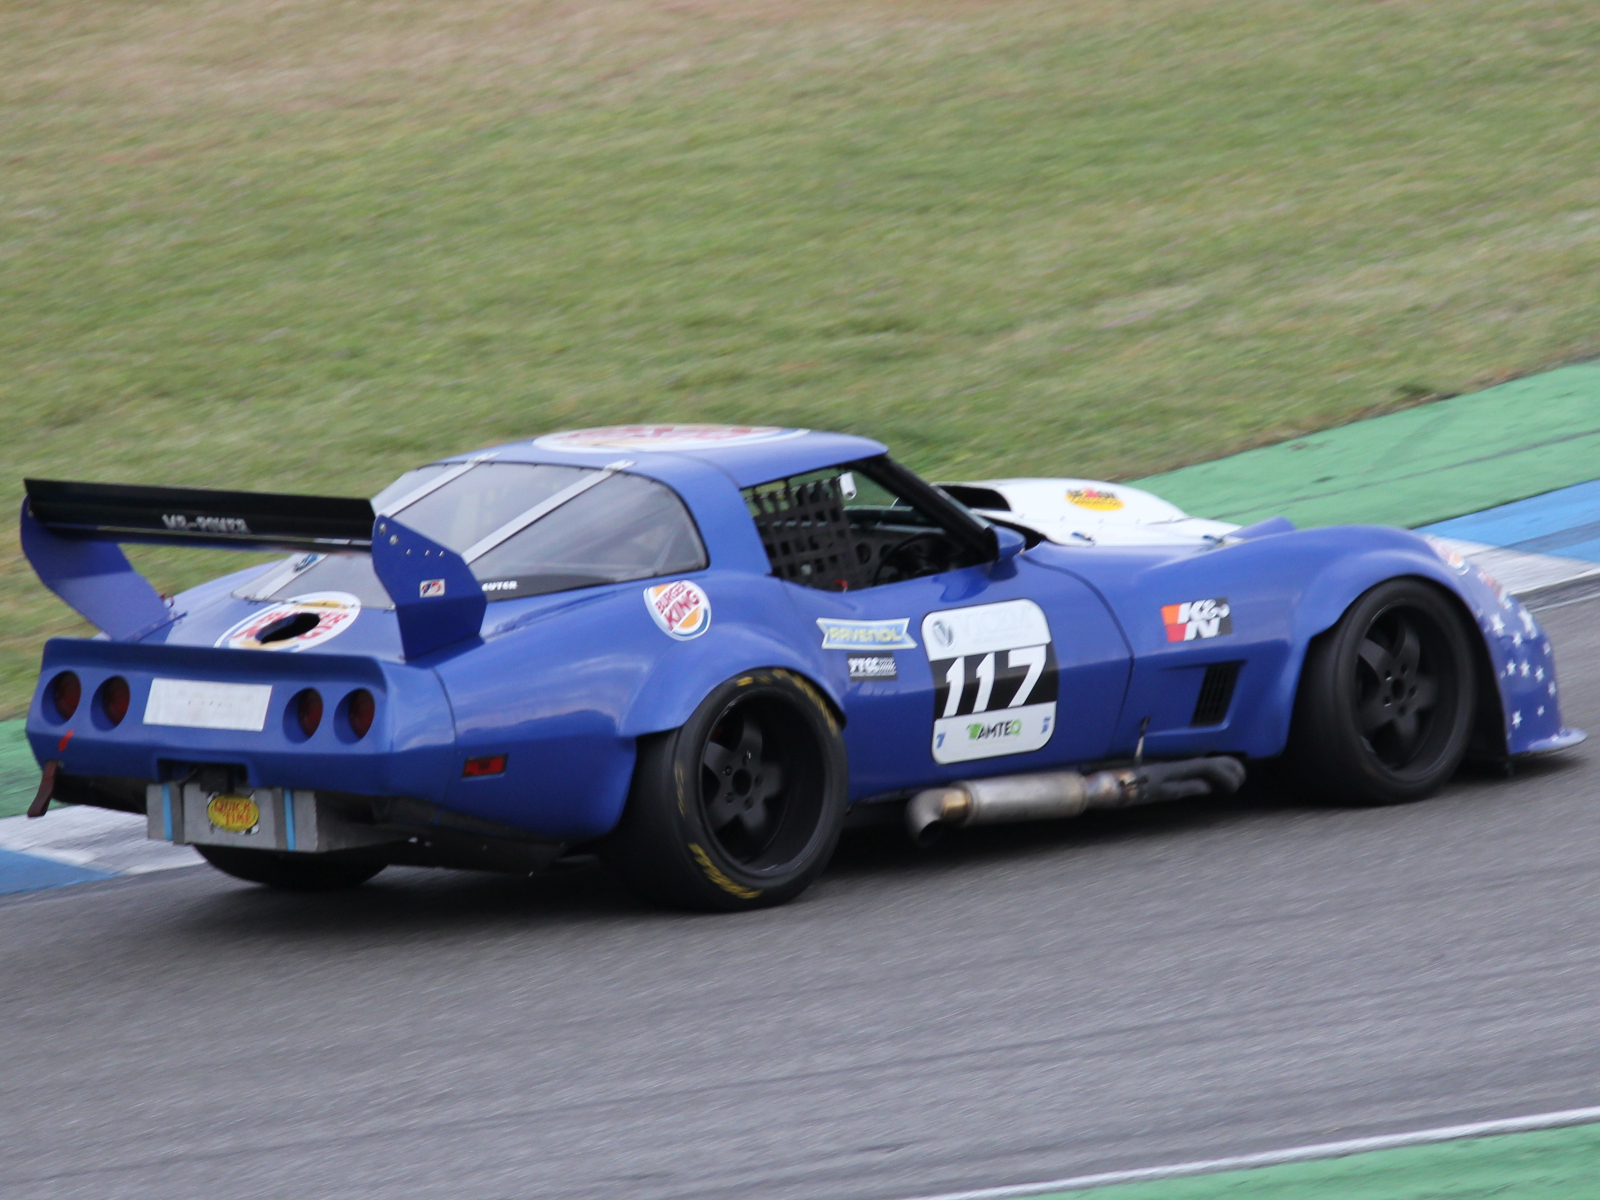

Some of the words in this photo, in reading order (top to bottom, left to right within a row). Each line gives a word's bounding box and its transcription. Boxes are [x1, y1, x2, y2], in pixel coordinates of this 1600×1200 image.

[664, 589, 700, 632] KING
[828, 626, 903, 642] RAVENOL
[941, 645, 1047, 719] 117
[214, 799, 252, 814] QUICK
[222, 811, 253, 826] TIME
